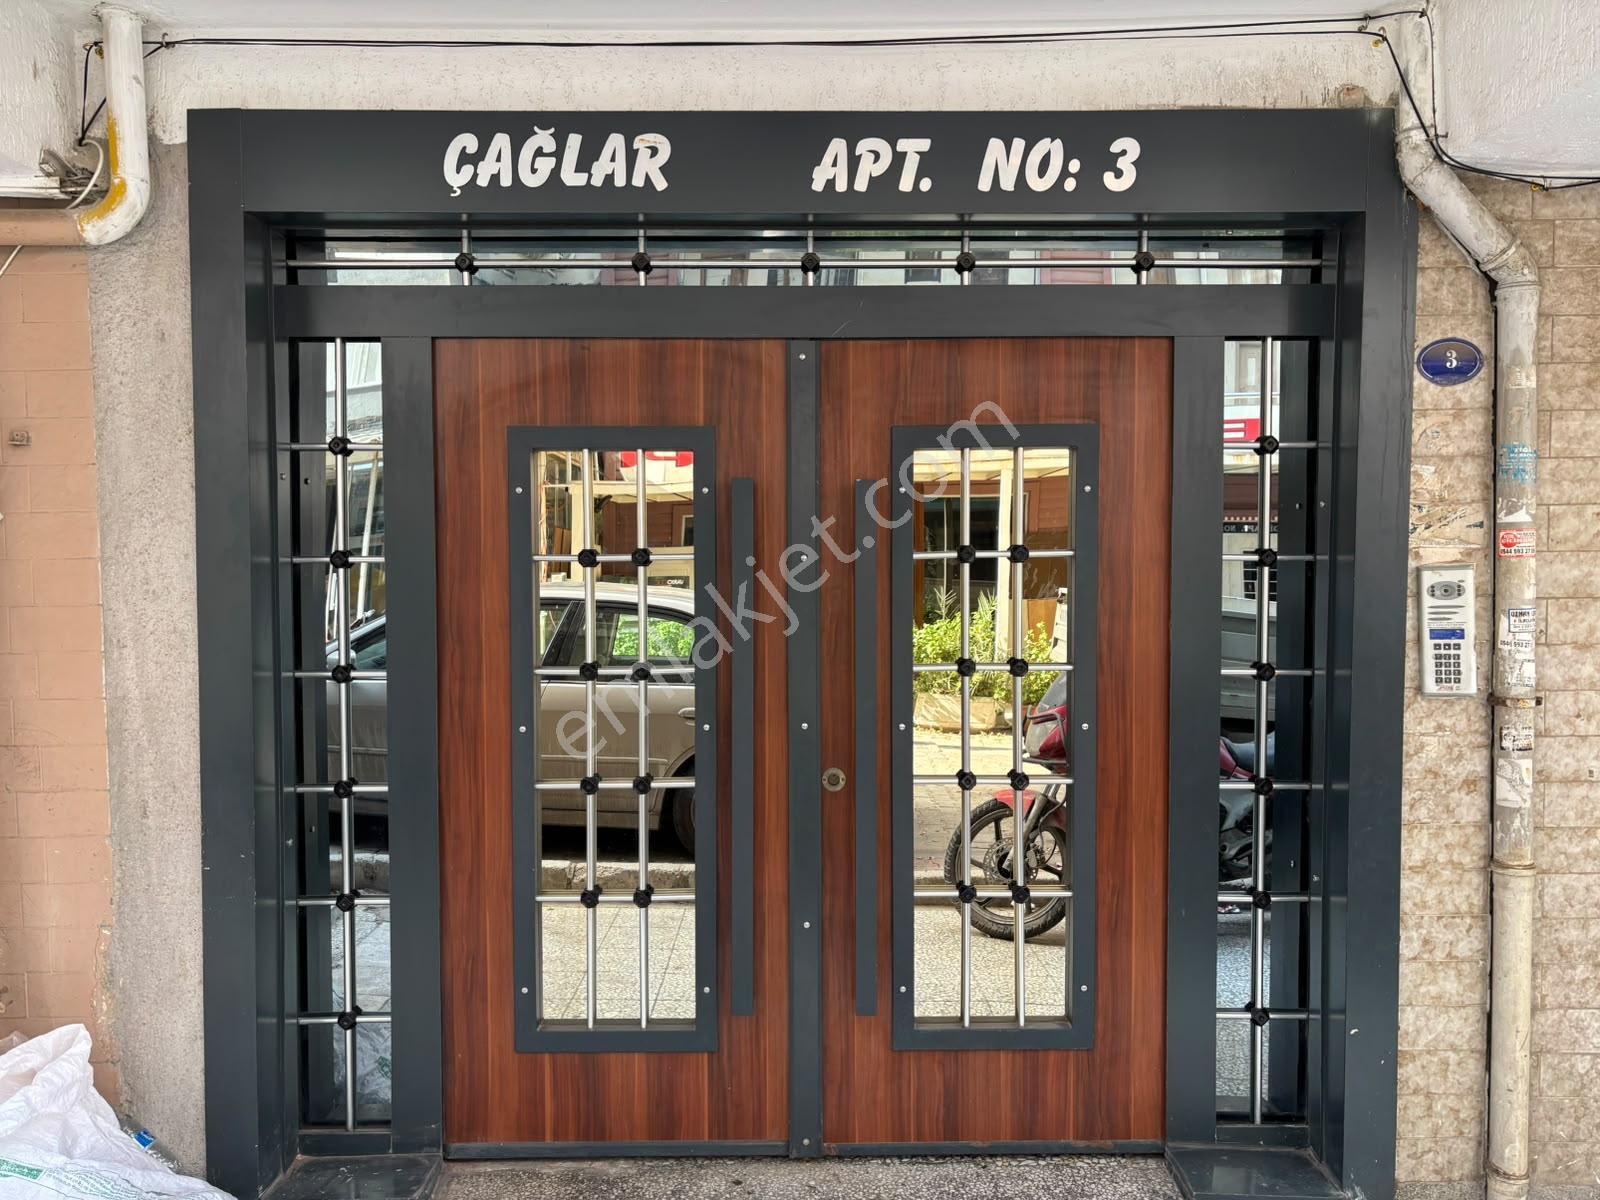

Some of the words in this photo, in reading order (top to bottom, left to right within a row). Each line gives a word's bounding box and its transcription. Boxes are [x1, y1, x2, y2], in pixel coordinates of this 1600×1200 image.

[443, 125, 673, 197] ÇAĞLAR
[810, 137, 933, 193] APT.
[977, 137, 1081, 193] NO:
[1102, 136, 1142, 193] 3
[1445, 349, 1458, 369] 3
